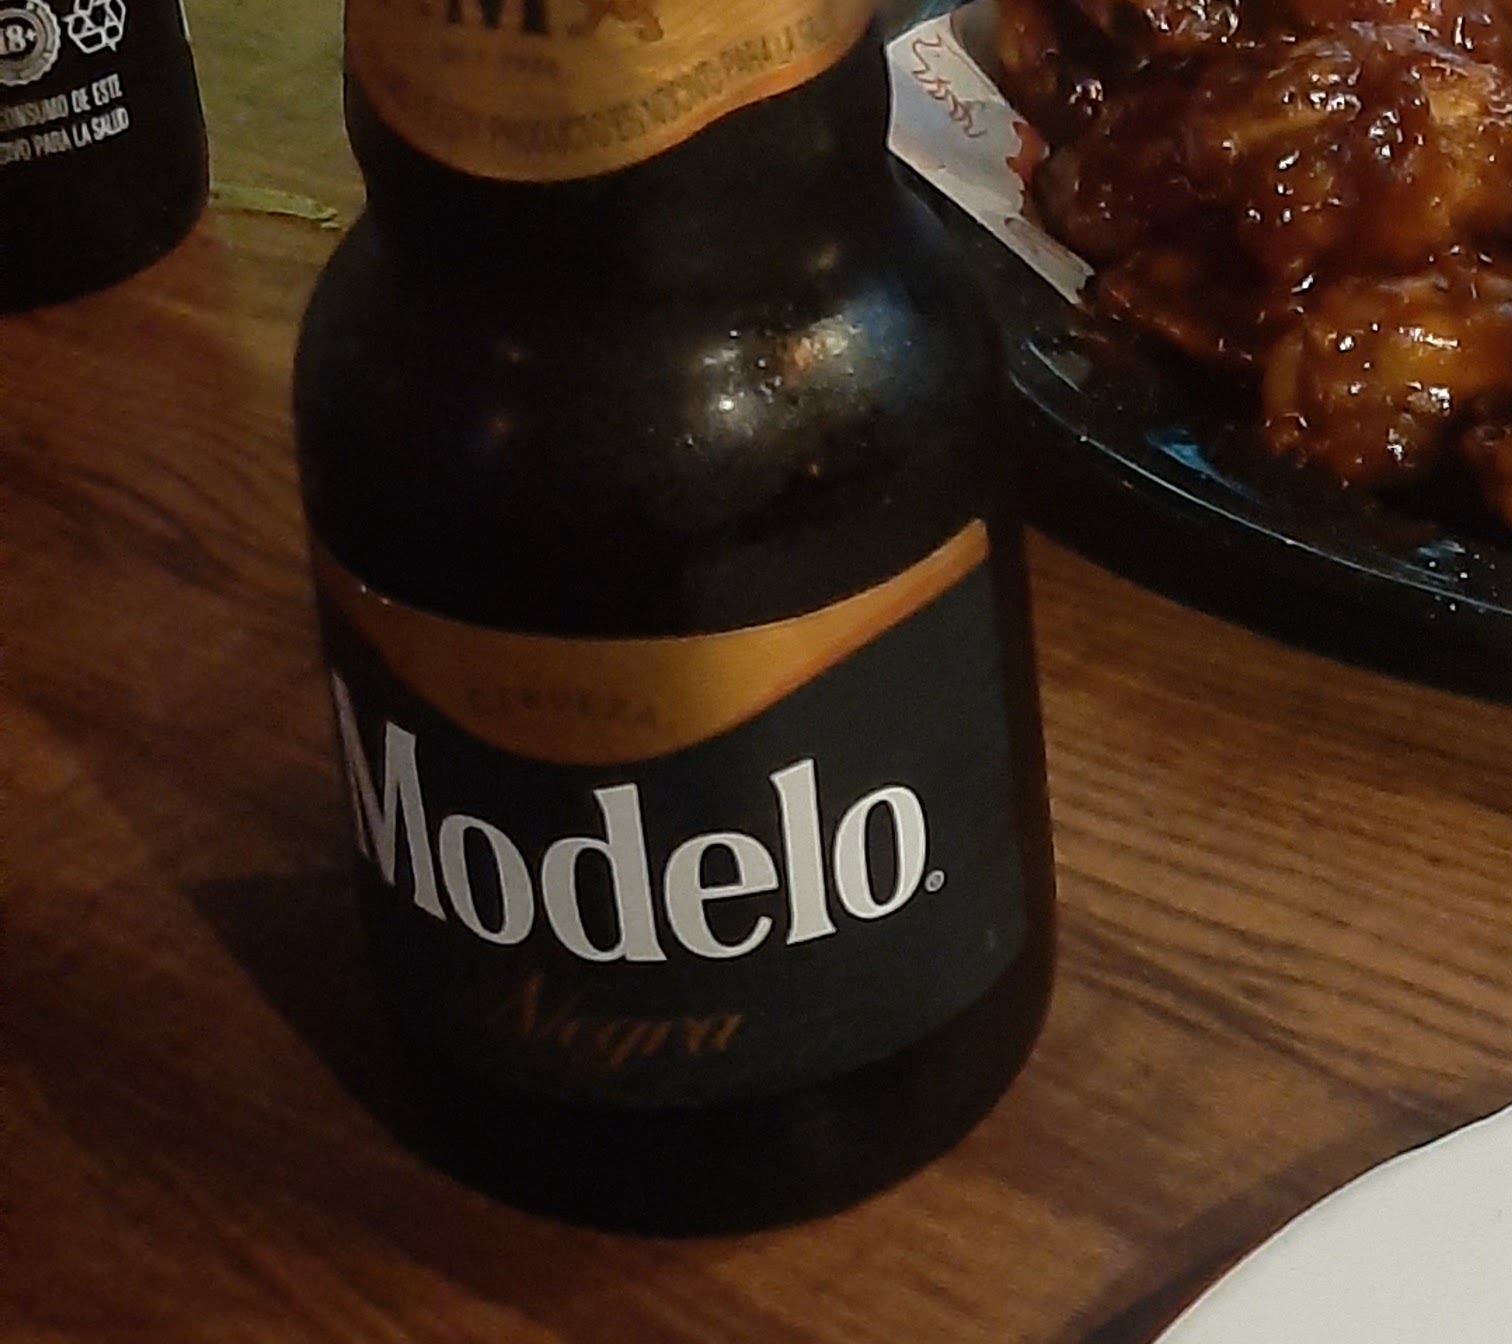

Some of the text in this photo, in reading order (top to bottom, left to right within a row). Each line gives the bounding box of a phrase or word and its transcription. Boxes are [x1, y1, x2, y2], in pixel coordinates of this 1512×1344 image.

[71, 87, 91, 113] DE
[92, 73, 123, 106] ESTE
[33, 127, 72, 158] PARA
[72, 122, 93, 149] LA
[91, 107, 130, 142] SALUD
[333, 667, 927, 962] Modelo
